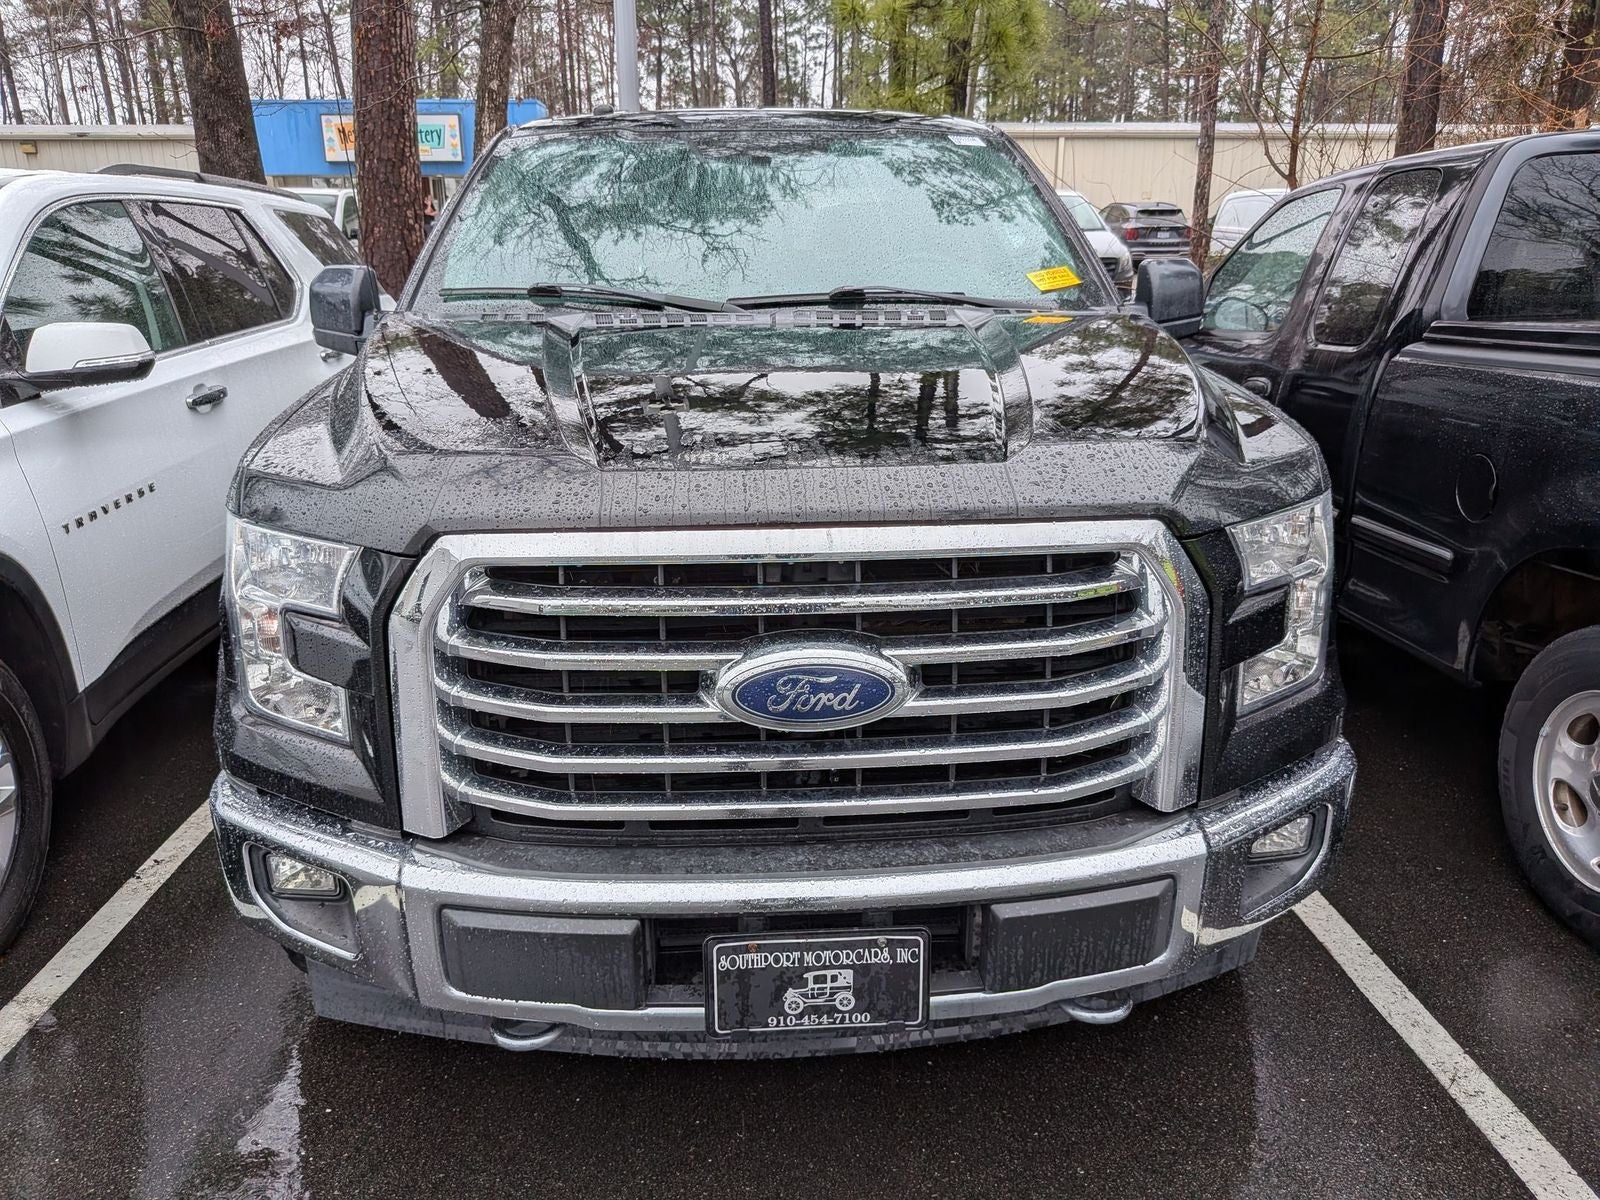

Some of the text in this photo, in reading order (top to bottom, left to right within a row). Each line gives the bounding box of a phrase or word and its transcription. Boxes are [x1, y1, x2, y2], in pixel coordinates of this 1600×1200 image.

[337, 127, 442, 146] Me tery
[62, 482, 156, 535] TRAVERSE
[766, 674, 862, 713] Ford
[718, 948, 919, 971] SOUTHPORT MOTORCARS, INC
[767, 1012, 871, 1027] 910-454-7100
